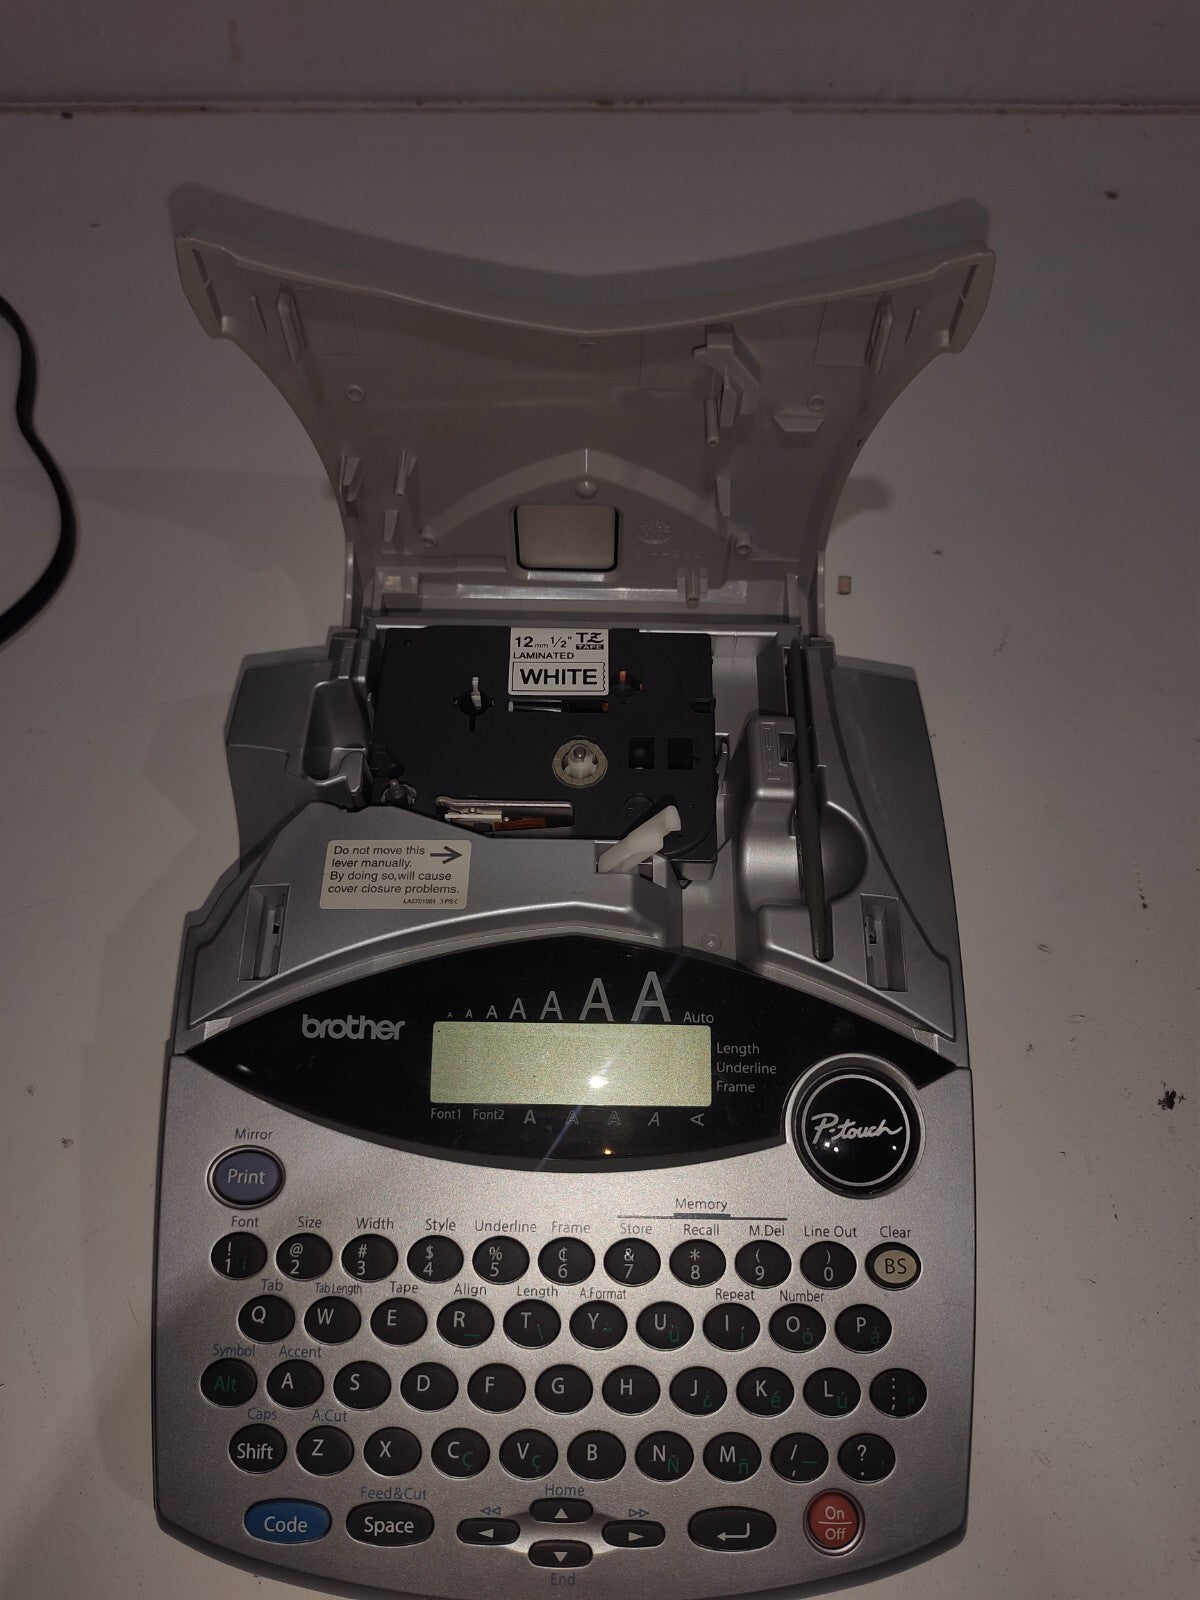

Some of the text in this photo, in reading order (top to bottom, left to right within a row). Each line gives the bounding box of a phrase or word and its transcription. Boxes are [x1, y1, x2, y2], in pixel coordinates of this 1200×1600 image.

[513, 652, 574, 660] LAMINATED
[519, 668, 597, 685] WHITE
[333, 845, 425, 855] Do not move this
[331, 858, 412, 869] lever manually.
[329, 871, 345, 882] By
[347, 871, 378, 882] doing
[418, 873, 452, 881] cause
[328, 884, 459, 895] cover closure problems.
[465, 1008, 473, 1018] A
[486, 1005, 498, 1019] A
[509, 997, 527, 1019] A
[539, 990, 563, 1020] A
[579, 977, 614, 1022] A
[630, 971, 671, 1022] A
[683, 1011, 714, 1024] Auto
[301, 1014, 405, 1041] brother
[716, 1042, 760, 1057] Length
[716, 1062, 777, 1075] Underline
[716, 1081, 755, 1093] Frame
[430, 1108, 462, 1120] Font1
[473, 1109, 505, 1121] Font2
[524, 1110, 537, 1124] A
[565, 1110, 579, 1125] A
[607, 1111, 622, 1126] A
[648, 1111, 660, 1126] A
[234, 1128, 273, 1140] Mirror
[227, 1168, 266, 1186] Print
[675, 1197, 728, 1212] Memory
[231, 1216, 259, 1228] Font
[298, 1216, 322, 1229] Size
[356, 1217, 394, 1230] Width
[425, 1218, 456, 1232] Style
[475, 1220, 537, 1233] Underline
[551, 1221, 591, 1234] Frame
[620, 1223, 652, 1235] Store
[683, 1223, 720, 1236] Recall
[749, 1224, 786, 1237] M.Del
[803, 1225, 857, 1238] Line Out
[879, 1225, 911, 1239] Clear
[225, 1258, 232, 1273] 1
[290, 1259, 300, 1274] 2
[357, 1260, 366, 1275] 3
[423, 1262, 434, 1276] 4
[489, 1262, 500, 1277] 5
[558, 1263, 568, 1278] 6
[624, 1263, 634, 1278] 7
[690, 1264, 700, 1279] 8
[755, 1266, 765, 1280] 9
[884, 1258, 908, 1275] BS
[823, 1267, 834, 1282] 0
[261, 1278, 283, 1291] Tab
[315, 1282, 362, 1297] Tab Length
[390, 1281, 419, 1295] Tape
[453, 1282, 487, 1297] Align
[517, 1286, 558, 1299] Length
[580, 1287, 627, 1300] A.Format
[715, 1288, 755, 1302] Repeat
[779, 1289, 825, 1302] Number
[251, 1306, 267, 1324] Q
[317, 1308, 335, 1325] W
[387, 1309, 397, 1326] E
[453, 1311, 466, 1328] R
[520, 1312, 532, 1329] T
[587, 1313, 600, 1330] Y
[654, 1313, 667, 1331] U
[786, 1315, 800, 1333] O
[856, 1316, 867, 1333] P
[213, 1343, 256, 1358] Symbol
[278, 1345, 322, 1358] Accent
[213, 1375, 237, 1392] Alt
[281, 1372, 294, 1390] A
[350, 1373, 360, 1391] S
[417, 1375, 430, 1391] D
[485, 1376, 495, 1393] F
[551, 1377, 565, 1394] G
[620, 1379, 633, 1396] H
[690, 1379, 698, 1397] J
[756, 1380, 768, 1397] K
[824, 1380, 834, 1397] L
[248, 1408, 277, 1423] Caps
[312, 1409, 347, 1423] A.Cut
[236, 1443, 274, 1460] Shift
[311, 1439, 324, 1456] Z
[378, 1441, 392, 1458] X
[447, 1442, 460, 1459] C
[516, 1442, 530, 1460] V
[587, 1444, 598, 1461] B
[652, 1445, 666, 1462] N
[719, 1445, 736, 1463] M
[856, 1444, 867, 1461] ?
[361, 1486, 427, 1501] Feed&Cut
[544, 1484, 585, 1496] Home
[825, 1505, 845, 1520] On
[264, 1515, 308, 1533] Code
[364, 1516, 415, 1534] Space
[825, 1527, 846, 1541] Off
[551, 1573, 576, 1586] End
